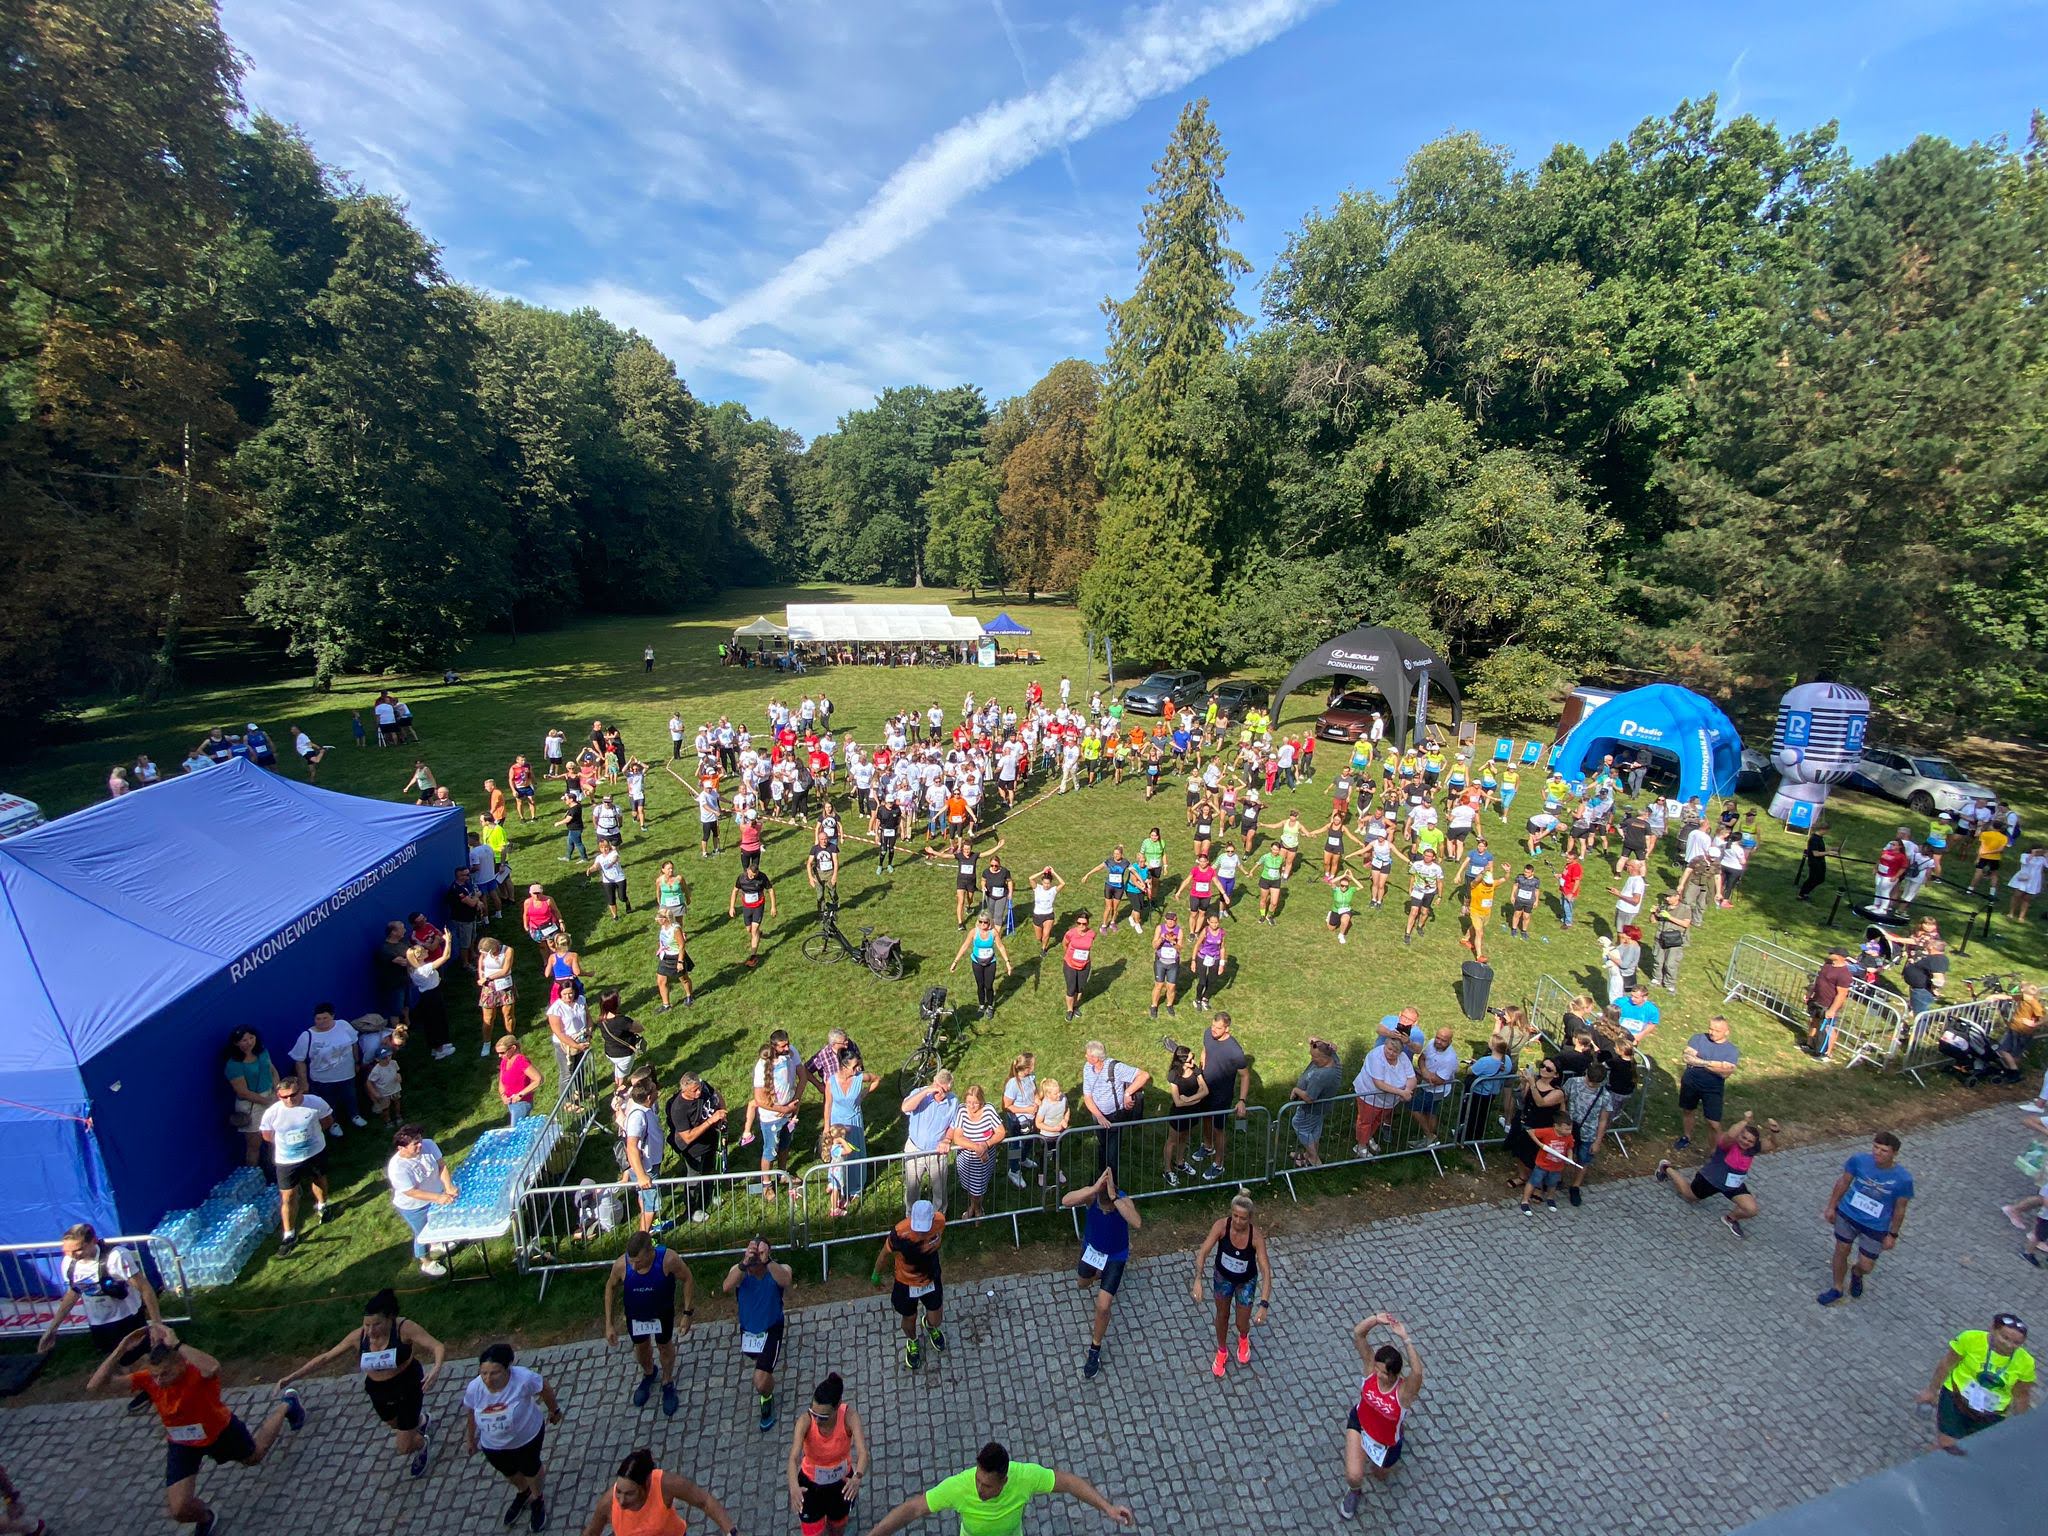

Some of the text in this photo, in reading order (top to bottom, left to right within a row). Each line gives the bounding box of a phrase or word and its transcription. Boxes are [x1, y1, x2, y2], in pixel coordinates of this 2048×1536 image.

[1344, 652, 1380, 662] LEXUS
[1638, 726, 1663, 737] Radio
[229, 901, 330, 984] RAKONIEWICKI
[379, 841, 418, 878] KULTURY
